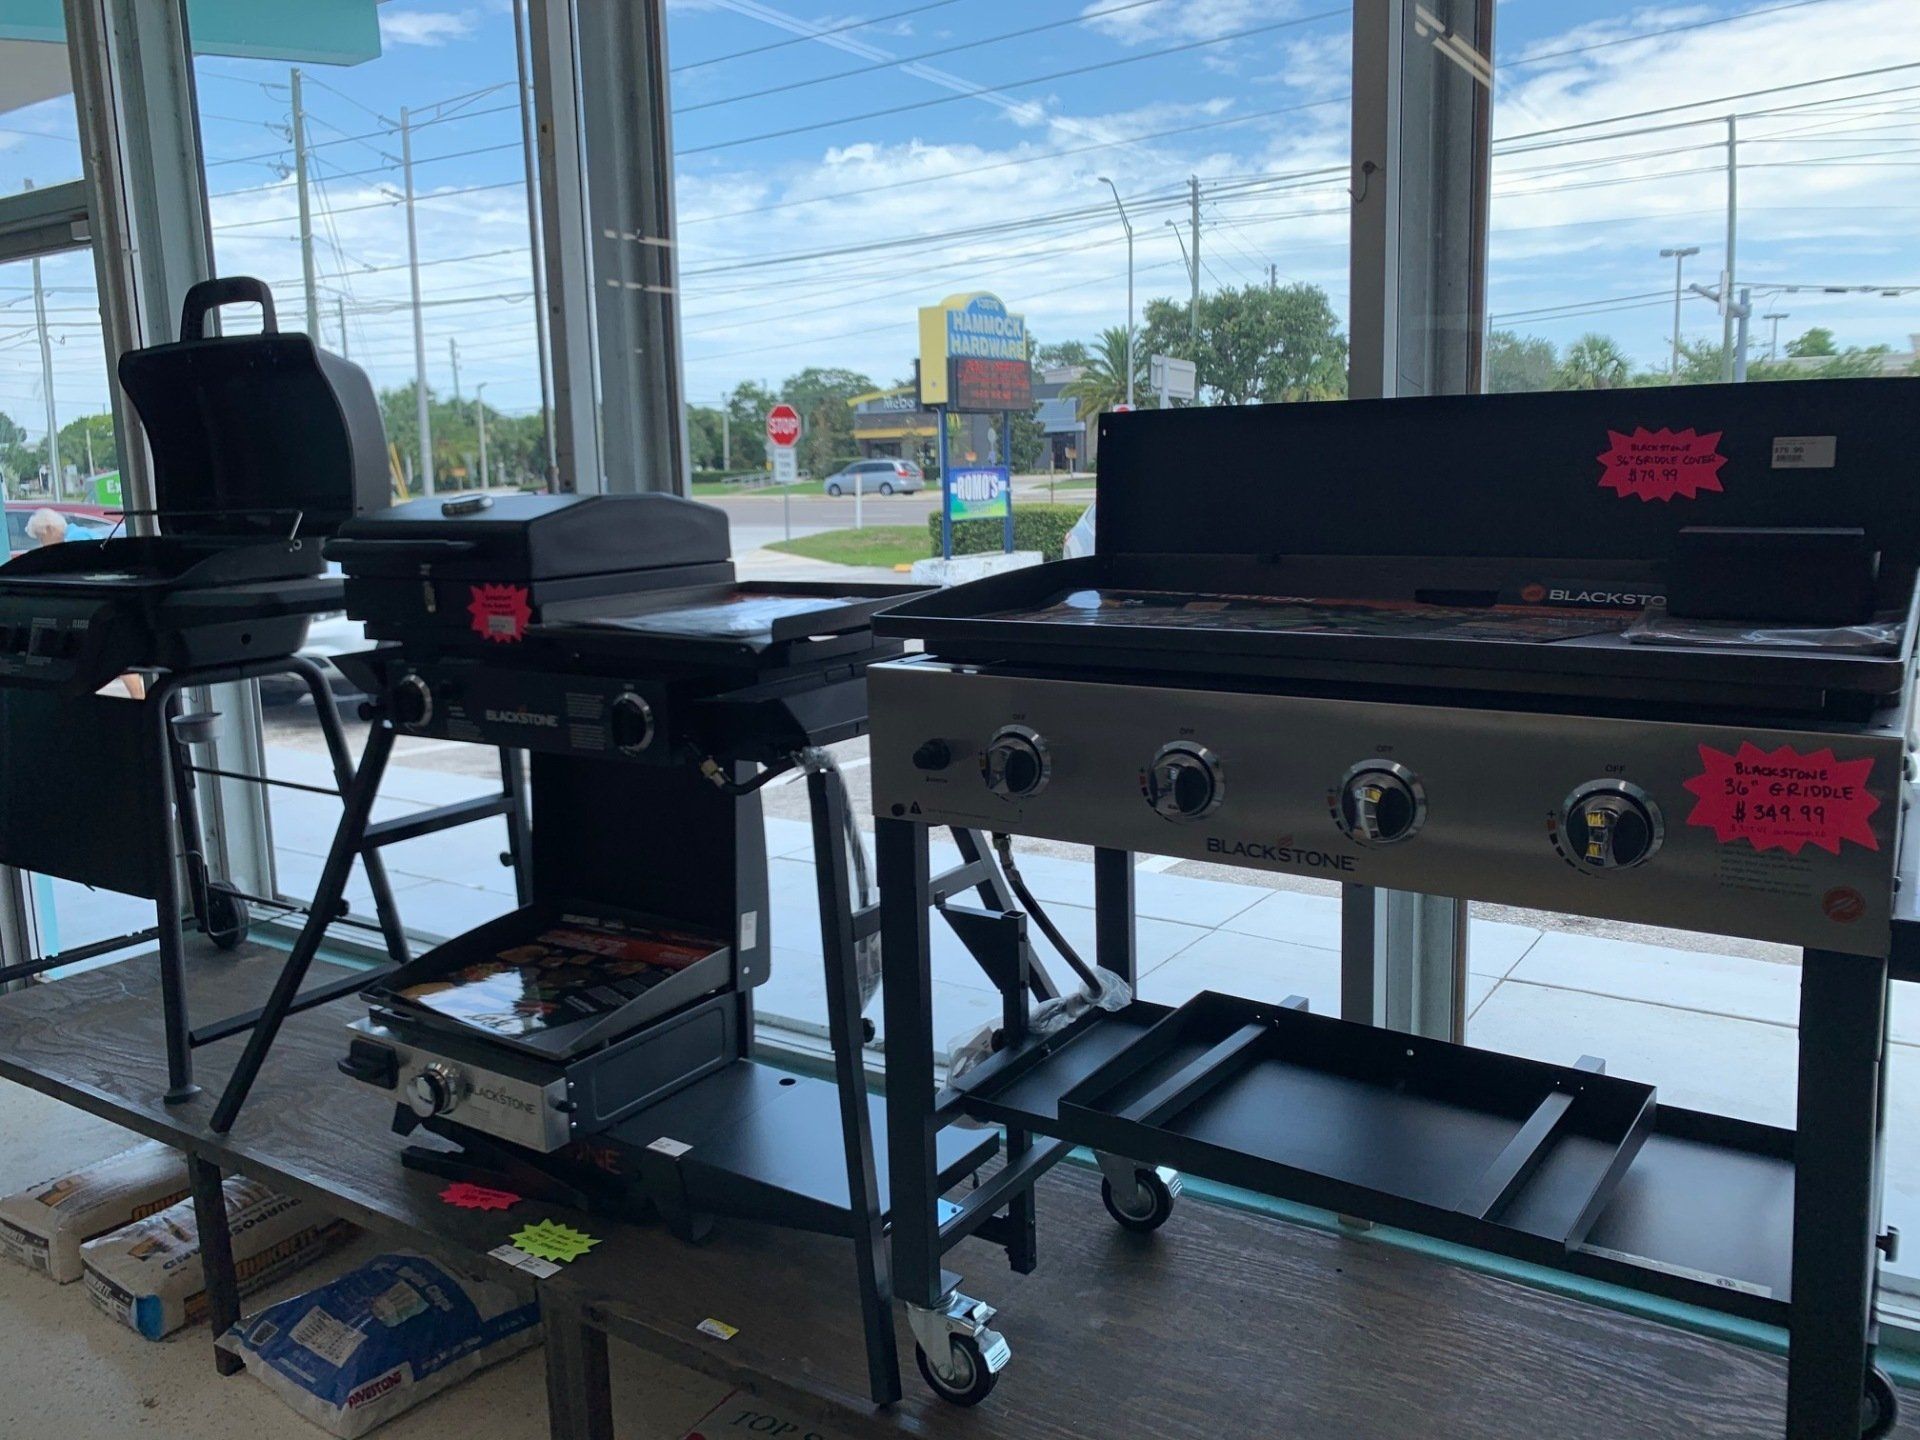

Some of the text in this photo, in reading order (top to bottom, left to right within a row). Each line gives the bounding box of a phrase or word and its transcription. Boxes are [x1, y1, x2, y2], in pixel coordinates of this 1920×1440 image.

[952, 311, 1022, 339] HAMMOCK
[950, 332, 1025, 361] HARDWARE
[768, 417, 798, 434] STOP
[1683, 453, 1716, 466] COVER
[956, 473, 999, 501] ROMO'S
[485, 709, 560, 728] BLACKSTONE
[1376, 745, 1393, 753] OFF
[1604, 764, 1627, 774] OFF
[1734, 762, 1829, 781] BLACKSTONE
[1724, 777, 1856, 801] 36" GRIDDLE
[1206, 837, 1359, 872] BLACKSTONE
[465, 1083, 536, 1115] LACKSTONE
[729, 1410, 799, 1435] TOP
